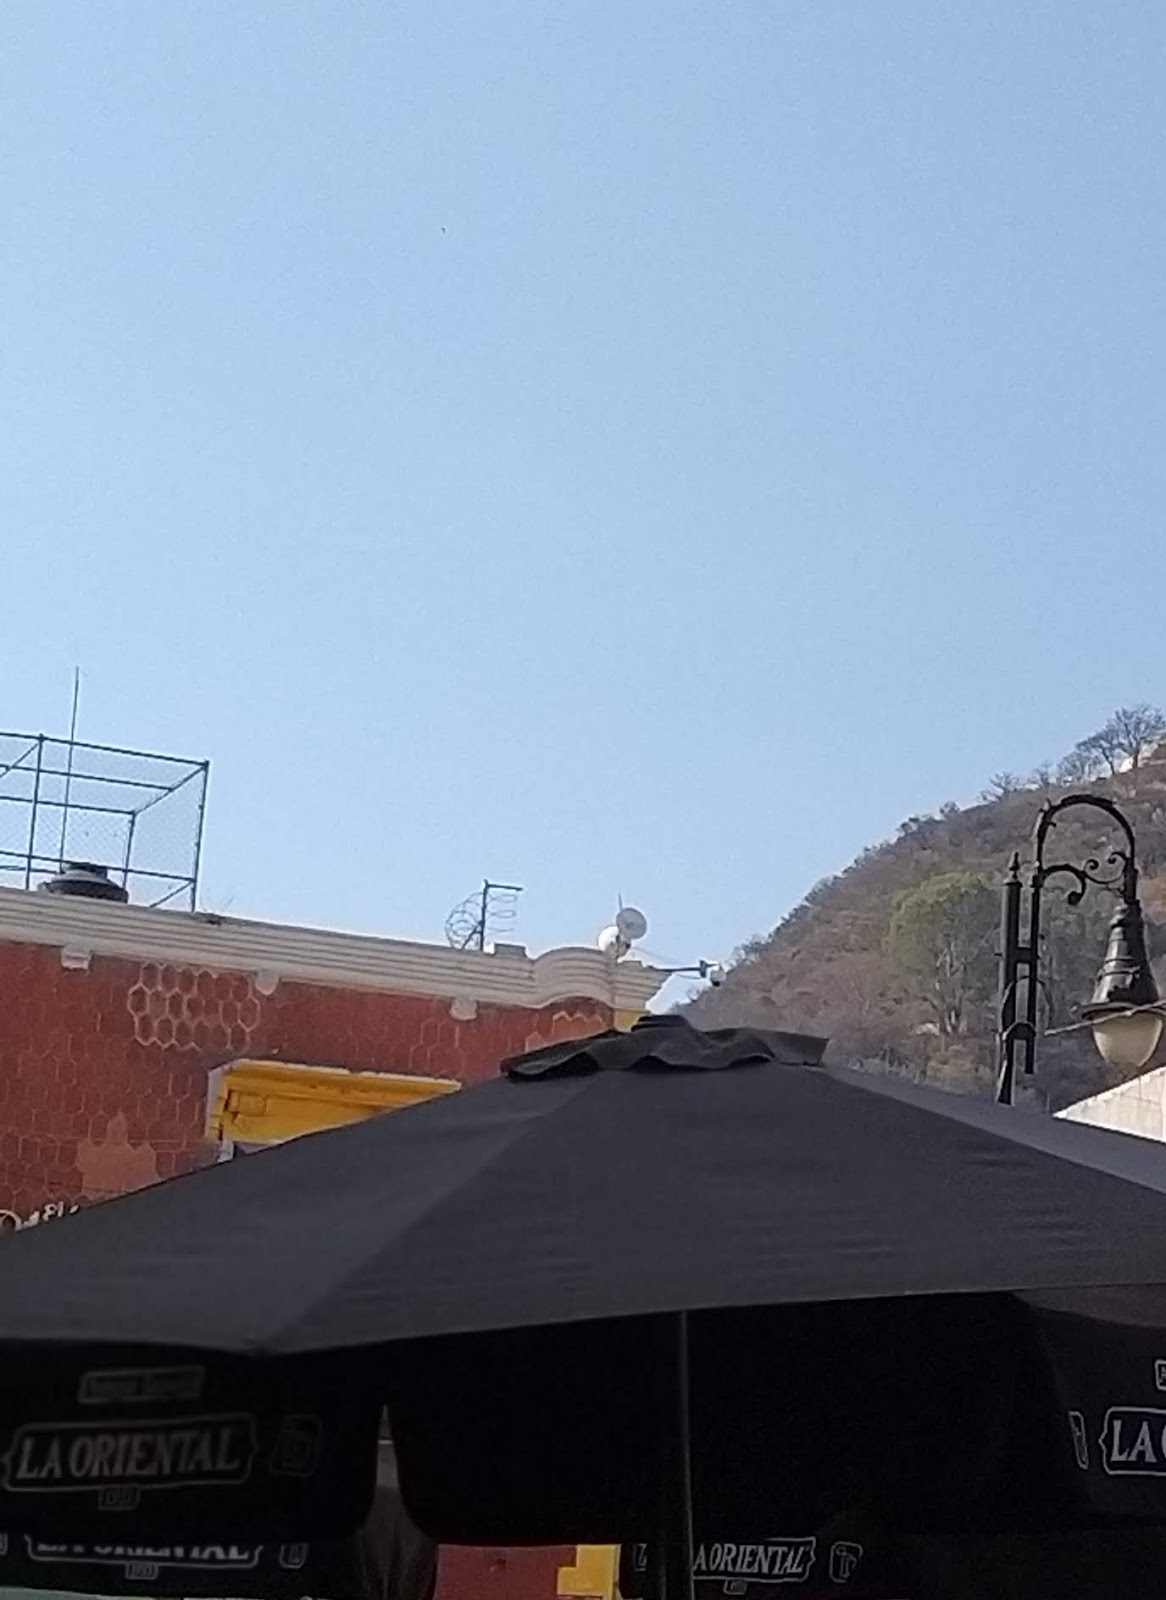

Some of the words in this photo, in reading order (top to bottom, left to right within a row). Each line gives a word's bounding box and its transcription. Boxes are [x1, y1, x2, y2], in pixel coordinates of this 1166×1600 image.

[17, 1436, 63, 1479] LA
[69, 1427, 240, 1477] ORIENTAL
[1110, 1418, 1158, 1463] LA
[708, 1542, 809, 1576] ORIENTAL
